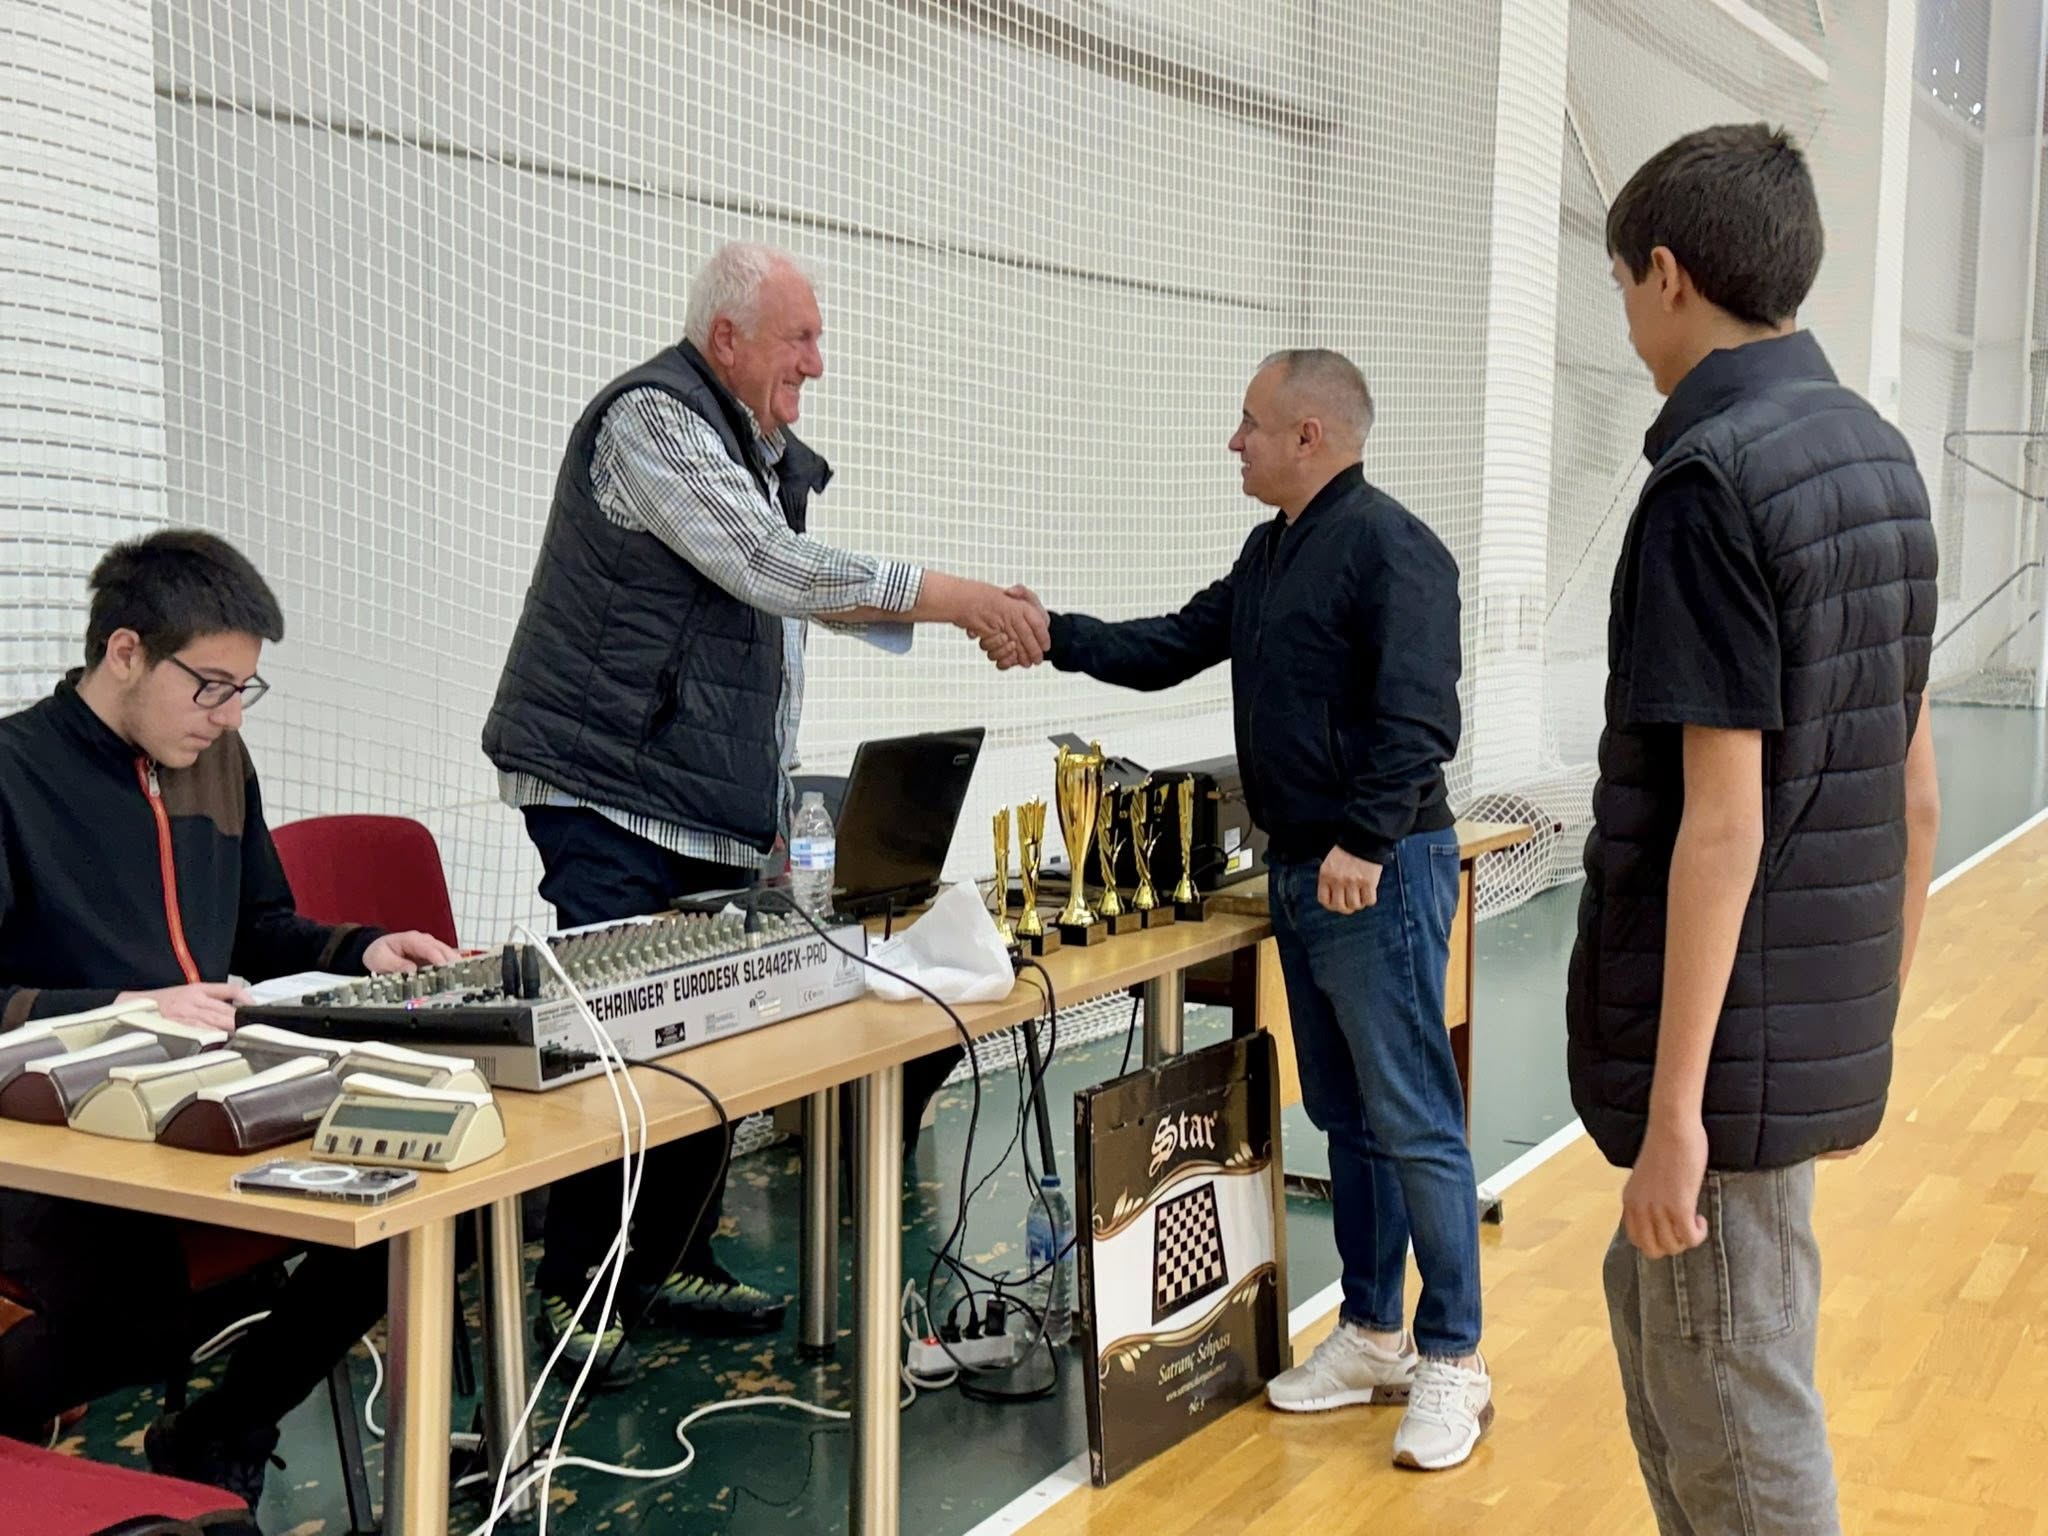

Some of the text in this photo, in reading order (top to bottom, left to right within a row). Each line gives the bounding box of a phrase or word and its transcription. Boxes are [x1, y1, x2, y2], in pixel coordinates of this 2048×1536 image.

[673, 962, 740, 1003] EURODESK
[743, 942, 828, 985] SL2442FX-PRO
[1149, 1110, 1217, 1178] Star
